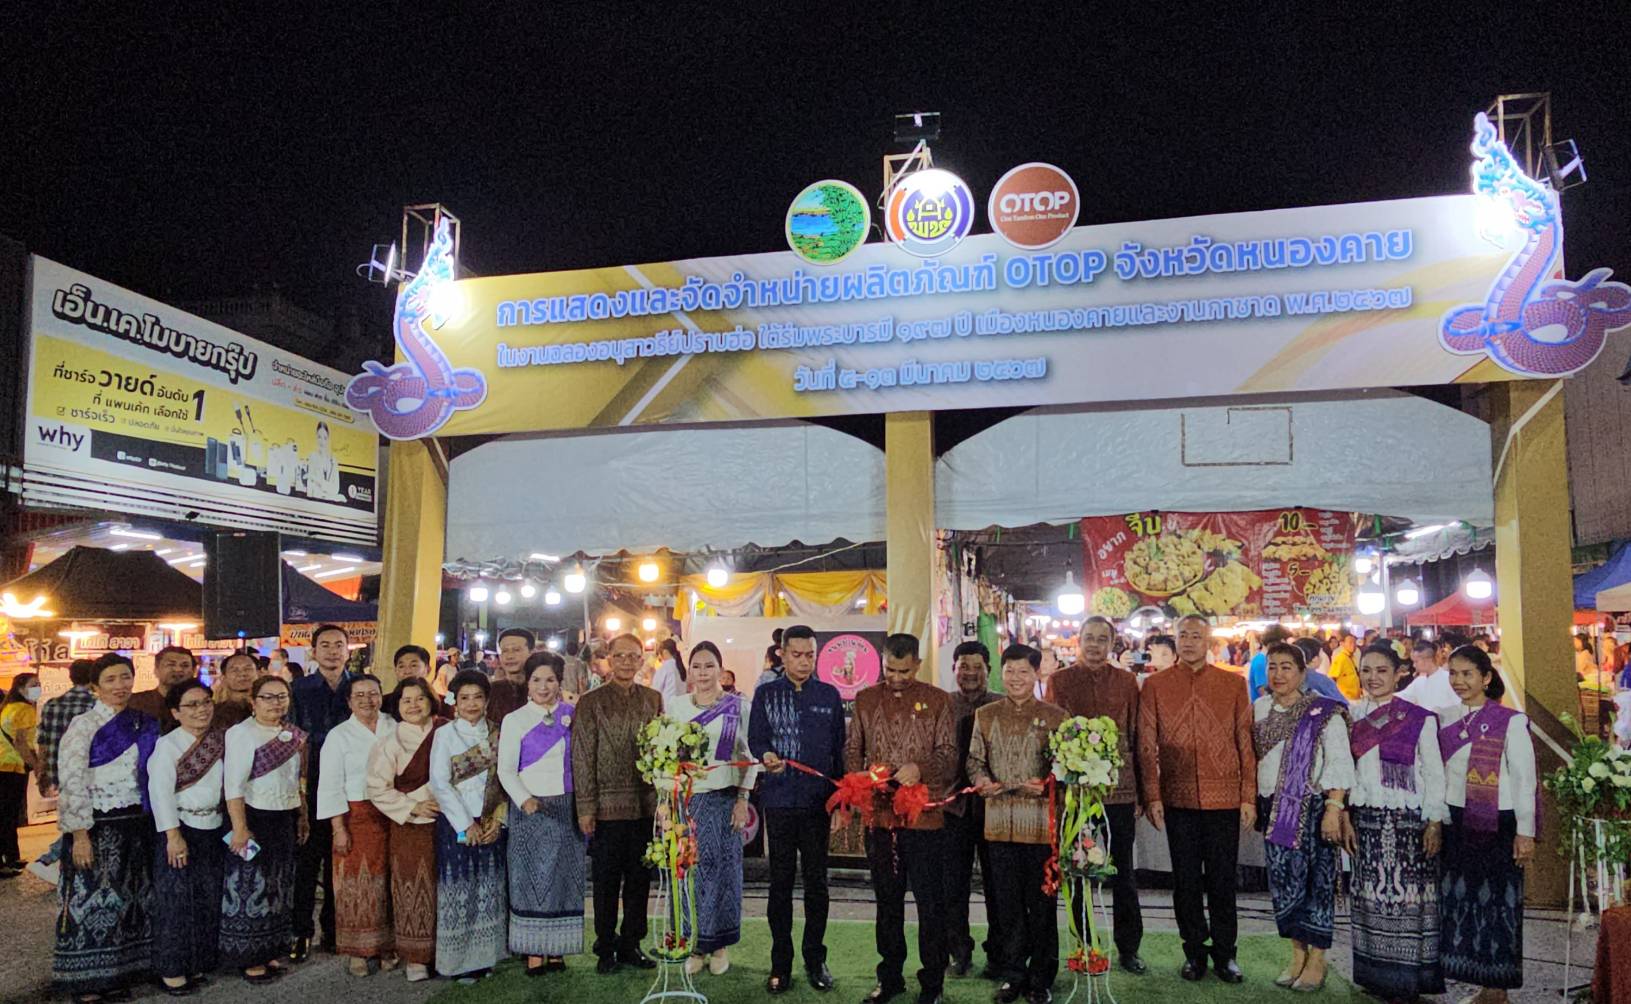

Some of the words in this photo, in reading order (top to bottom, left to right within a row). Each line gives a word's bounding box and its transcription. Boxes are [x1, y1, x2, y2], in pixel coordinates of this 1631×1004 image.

[1000, 191, 1070, 213] OTOP
[497, 253, 997, 326] การแสดงและจัดจำหน่ายผลิตภัณฑ์
[1005, 250, 1106, 288] OTOP
[1114, 228, 1414, 280] จังหวัดหนองคาย
[52, 283, 258, 384] เอ็น.เค.โมบายกรุ๊ป
[954, 311, 972, 337] ปี
[794, 358, 836, 391] วันที่
[900, 360, 970, 386] มีนาคม
[973, 357, 1047, 381] ๒๕๖๗
[53, 361, 96, 384] ที่ชาร์จ
[98, 370, 157, 397] วายด์
[156, 385, 189, 403] อันดับ
[192, 389, 206, 422] 1
[92, 390, 102, 405] ที่
[153, 407, 188, 421] เลือกใช้
[70, 406, 115, 424] ชาร์จเร็ว
[38, 424, 85, 452] why
